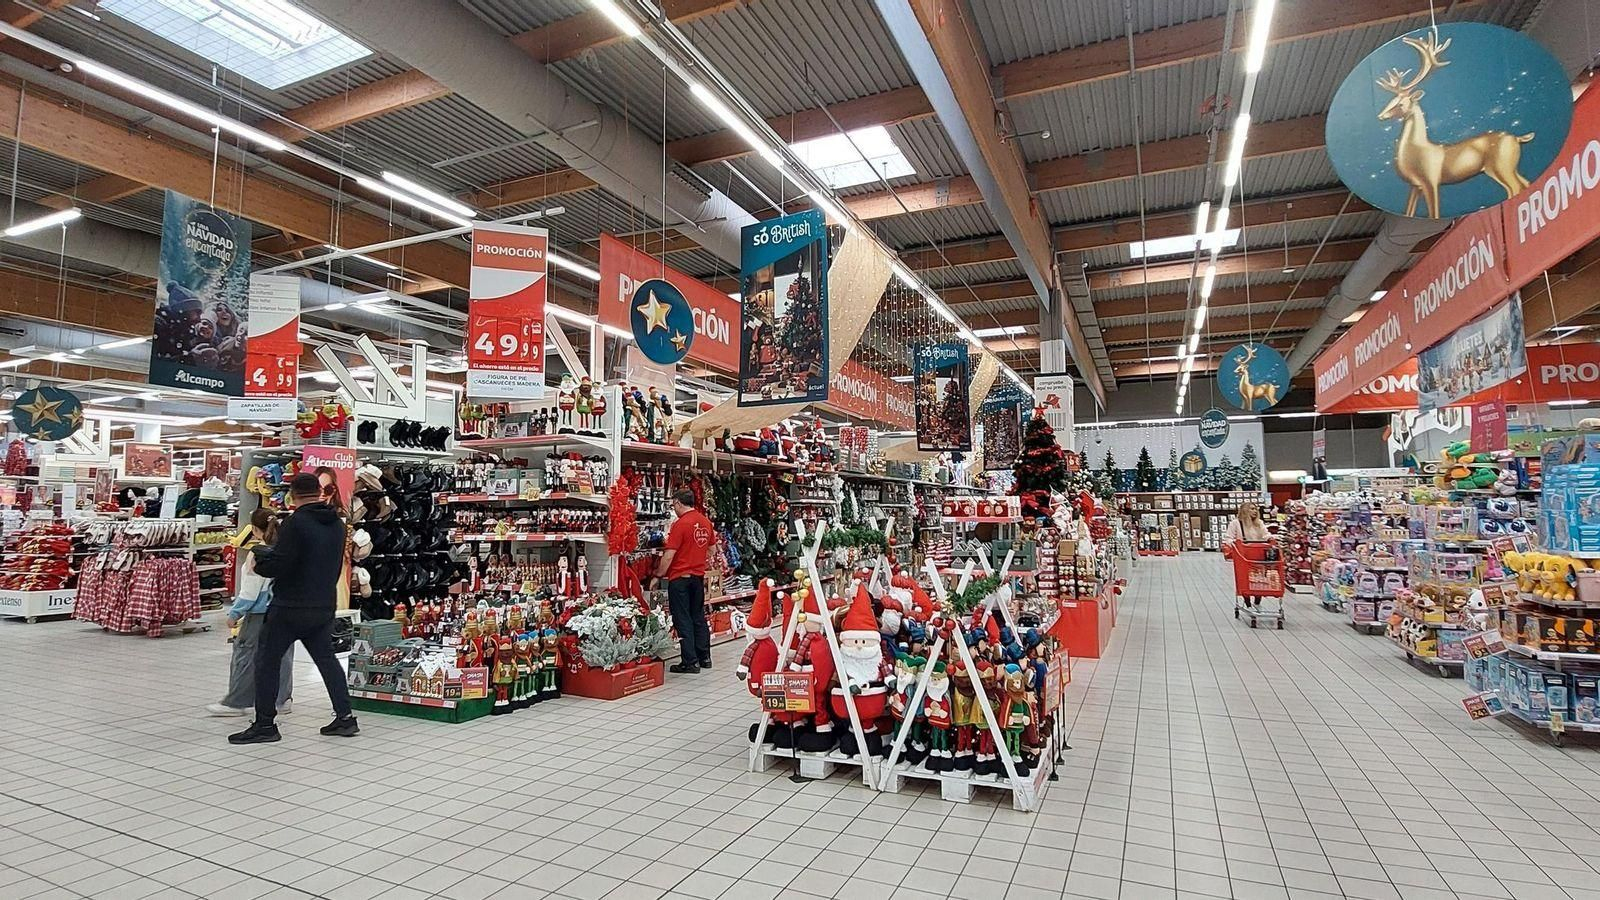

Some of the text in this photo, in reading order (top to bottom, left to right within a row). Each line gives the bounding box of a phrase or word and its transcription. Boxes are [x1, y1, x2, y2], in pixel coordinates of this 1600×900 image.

[185, 237, 231, 262] encantada
[187, 223, 234, 250] NAVIDAD
[476, 243, 543, 258] PROMOCIÓN
[1414, 233, 1495, 324] PROMOCIÓN
[619, 272, 730, 346] PCIÓN
[1354, 311, 1401, 368] PROMOCIÓN
[175, 369, 225, 388] Alcampo
[1317, 353, 1349, 394] PROMOCIÓN
[305, 454, 354, 470] Alcampo
[334, 452, 354, 462] Club
